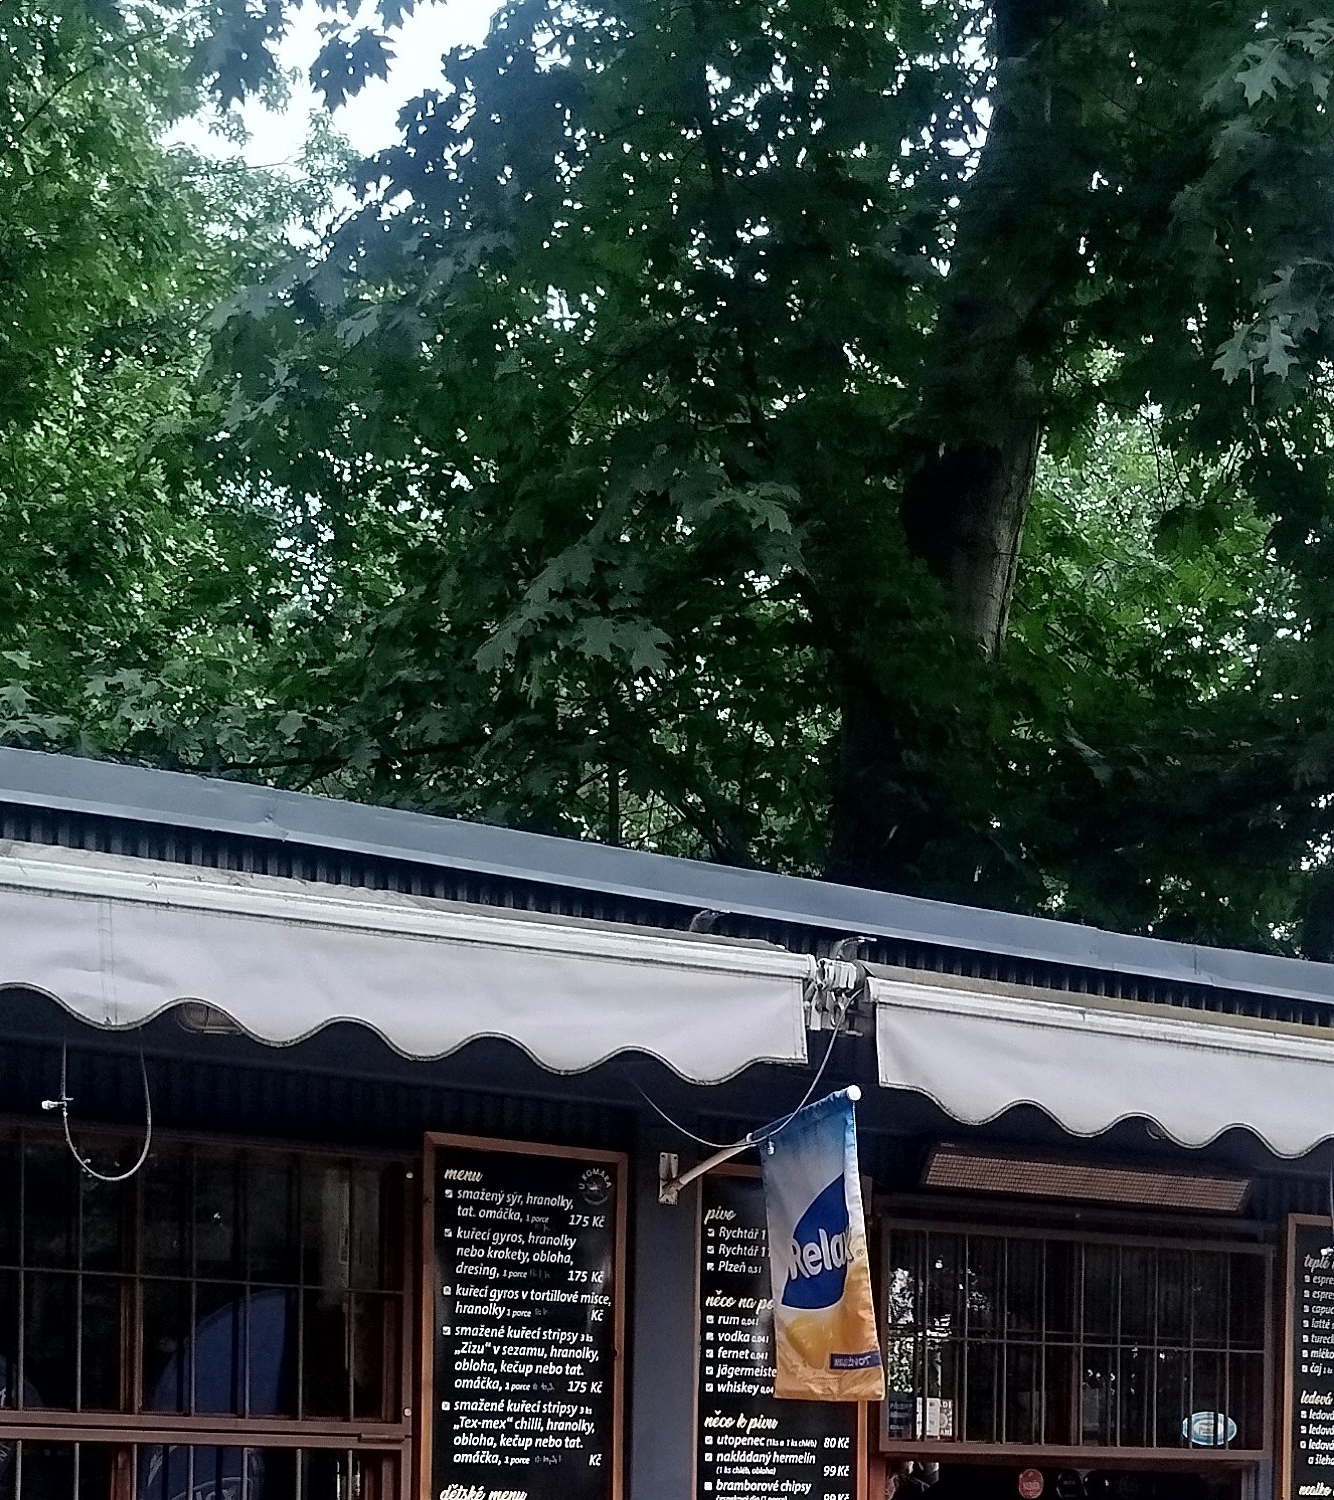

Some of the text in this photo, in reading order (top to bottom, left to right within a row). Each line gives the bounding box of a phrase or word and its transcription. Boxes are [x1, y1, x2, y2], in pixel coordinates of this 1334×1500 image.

[444, 1169, 483, 1182] menu
[457, 1188, 573, 1211] smažený sýr, hranolky,
[457, 1205, 523, 1222] tat. omáčka,
[704, 1206, 737, 1225] pivo
[457, 1226, 577, 1250] kuřecí gyros, hranolky
[719, 1226, 759, 1240] Rychtář
[456, 1245, 573, 1266] nebo krokety, obloha,
[456, 1261, 605, 1284] dresing, 175 Kč
[718, 1260, 746, 1273] Plzeň
[530, 1289, 611, 1307] tortillové misce,
[718, 1316, 740, 1325] rum
[718, 1330, 750, 1342] vodka
[502, 1346, 547, 1359] sezamu,
[717, 1346, 750, 1360] fernet
[716, 1363, 779, 1381] jägermeiste
[717, 1381, 760, 1396] whiskey
[1300, 1390, 1333, 1405] ledová
[514, 1417, 544, 1432] chilli,
[704, 1410, 778, 1435] něco k pivu
[1308, 1423, 1334, 1435] ledová
[717, 1434, 766, 1448] utopenec
[716, 1450, 816, 1466] nakládaný hermelín
[716, 1478, 812, 1495] bramborové chipsy
